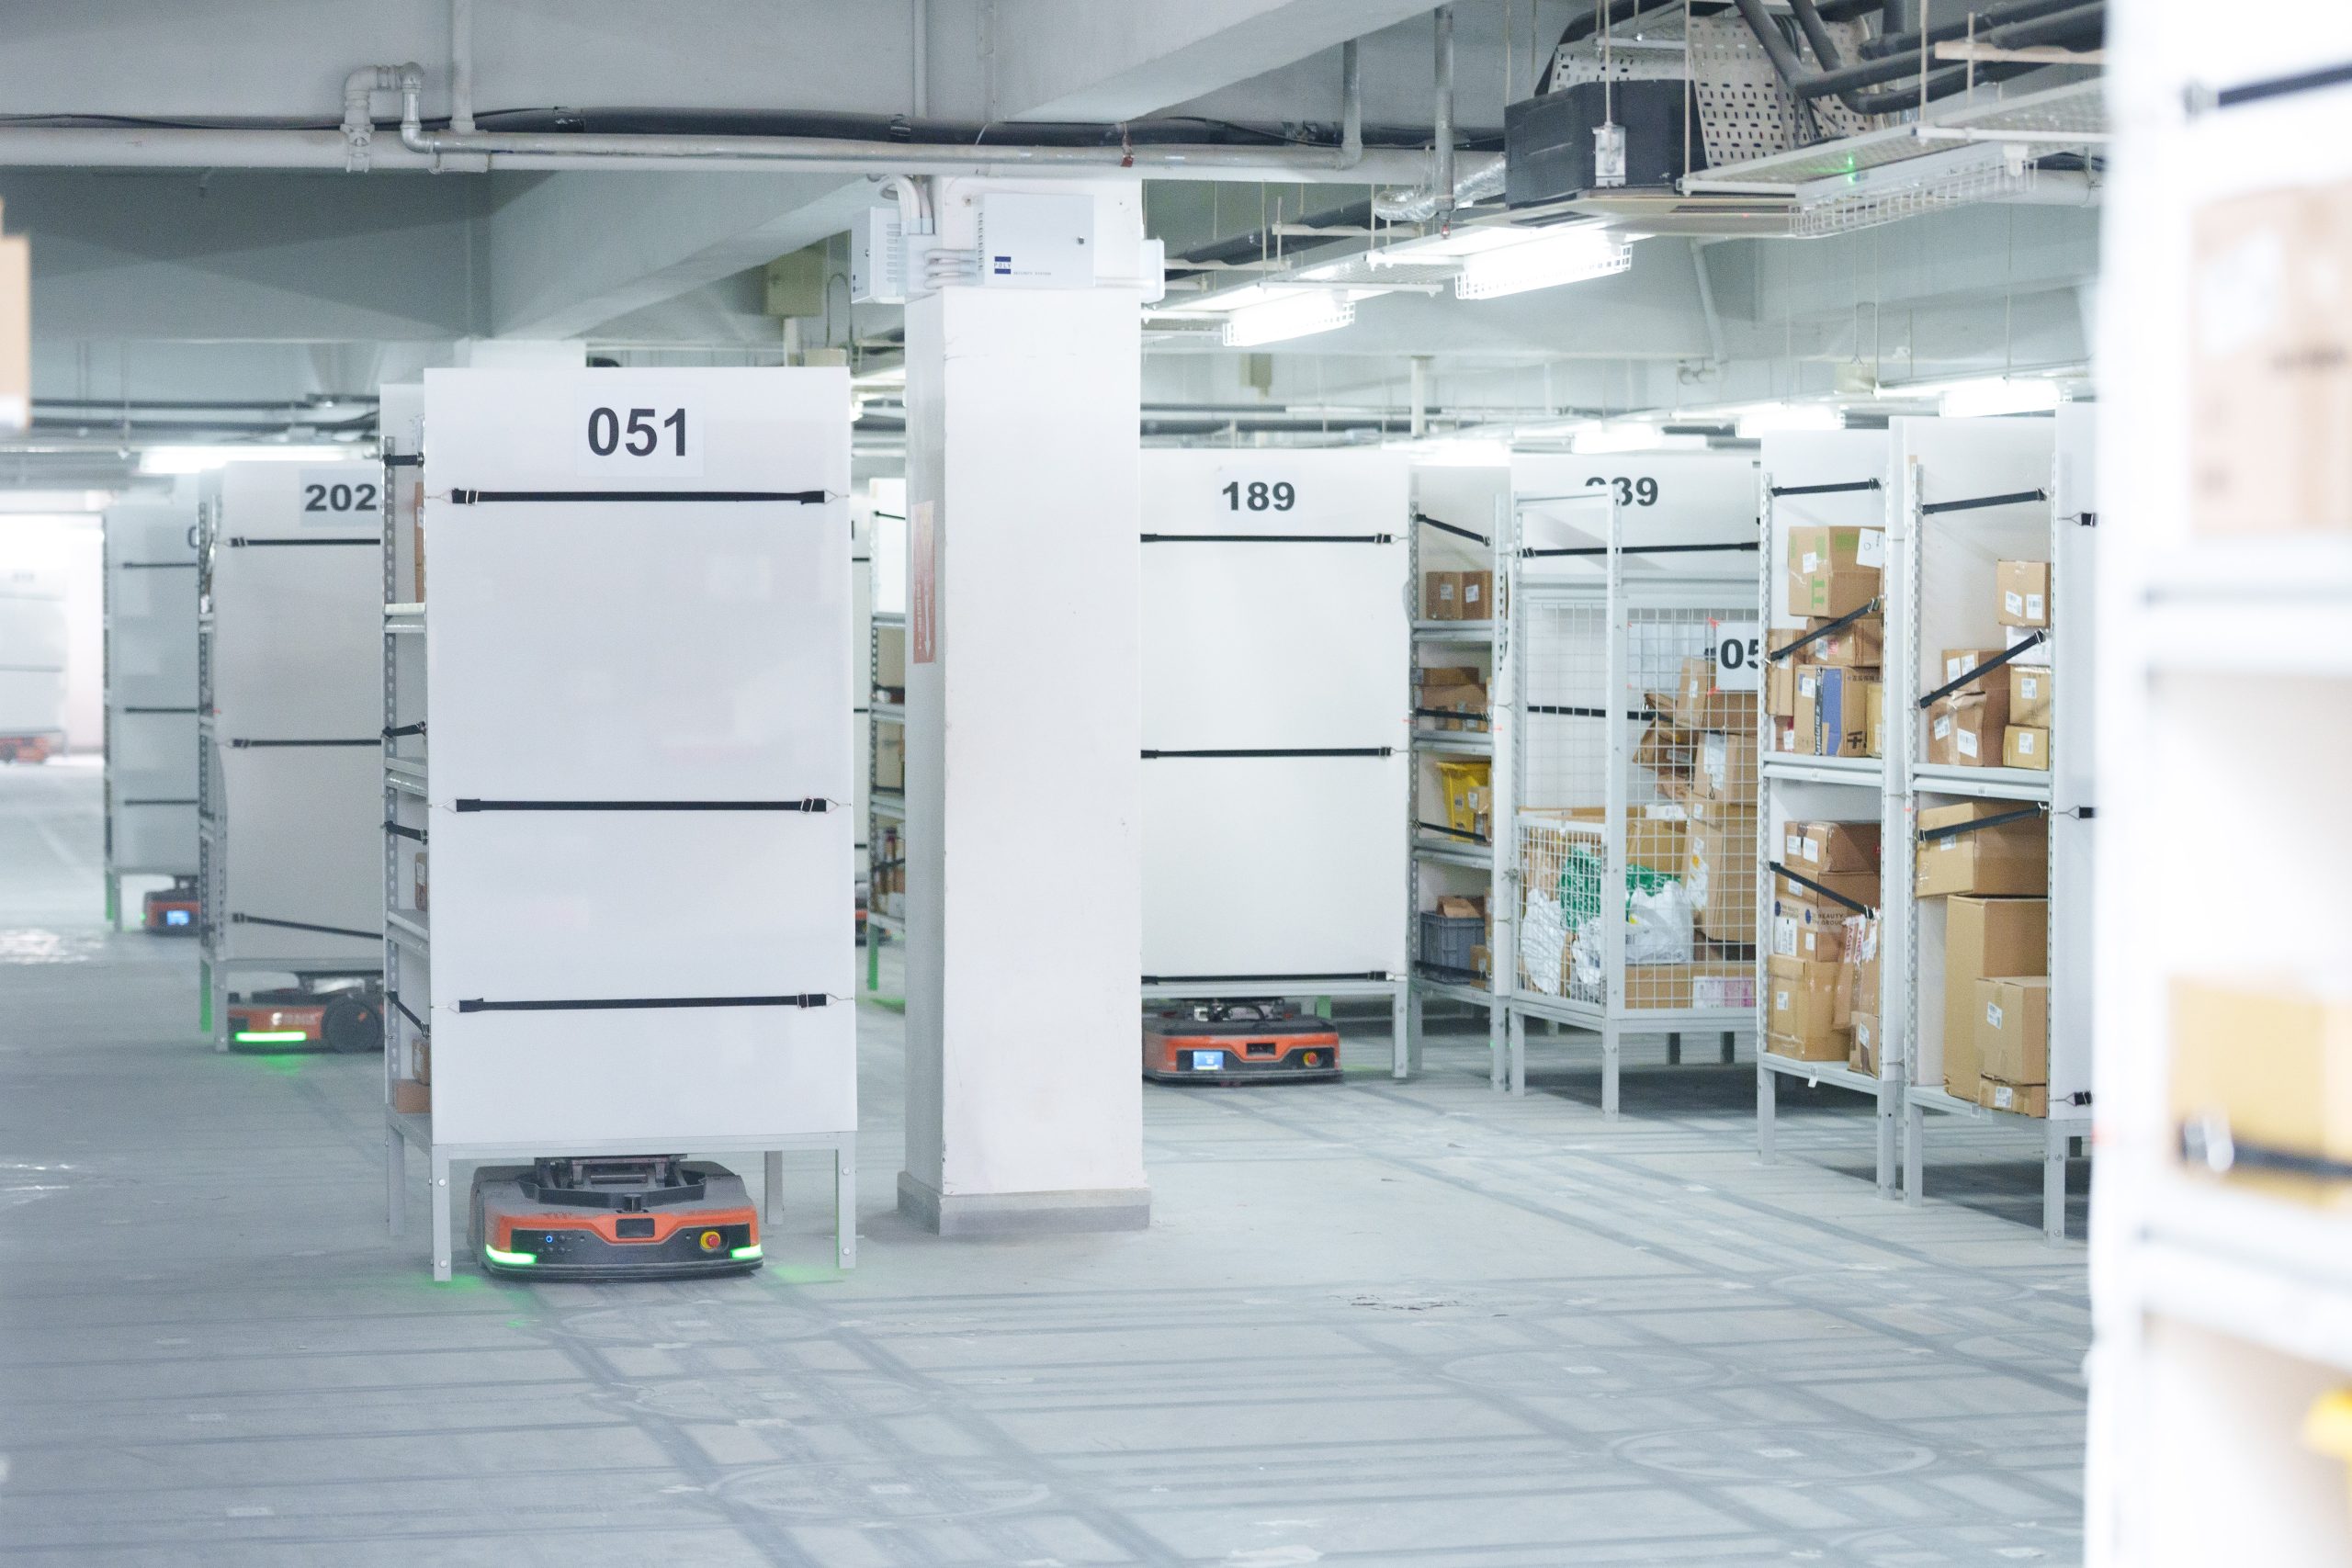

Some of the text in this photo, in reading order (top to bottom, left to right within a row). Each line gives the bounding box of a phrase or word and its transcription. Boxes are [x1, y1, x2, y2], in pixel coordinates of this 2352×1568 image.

[588, 407, 685, 457] 051
[304, 483, 378, 512] 202
[1222, 480, 1295, 512] 189
[1585, 476, 1658, 507] 39
